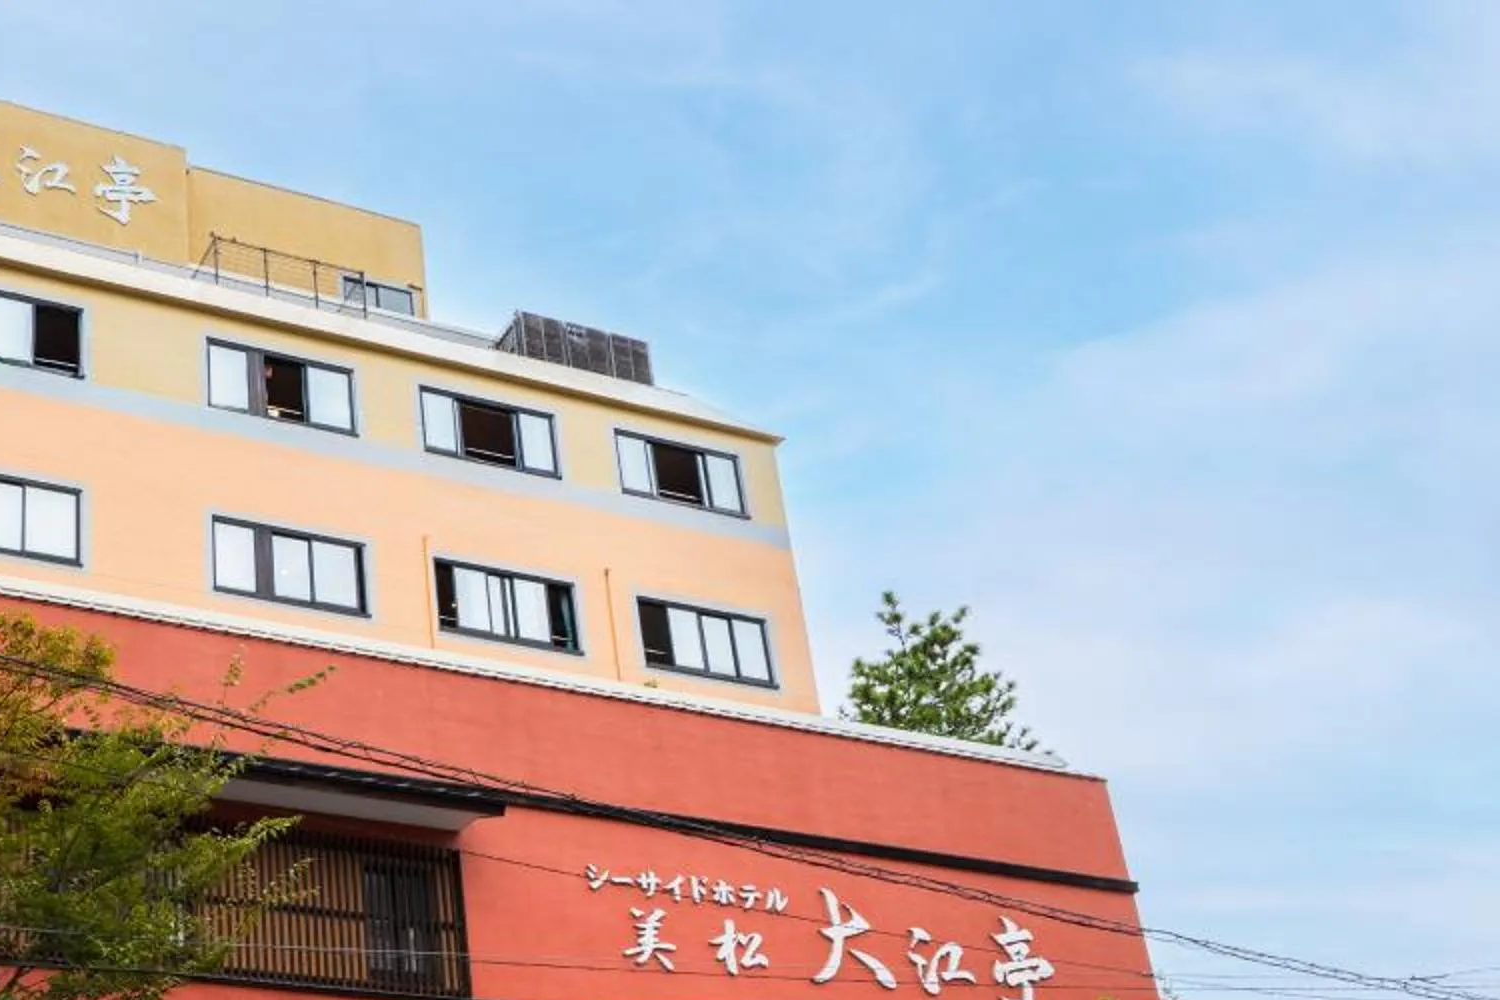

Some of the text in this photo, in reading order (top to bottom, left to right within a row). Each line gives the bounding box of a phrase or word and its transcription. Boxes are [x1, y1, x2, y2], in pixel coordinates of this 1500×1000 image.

[584, 863, 790, 913] シーサイドホテル
